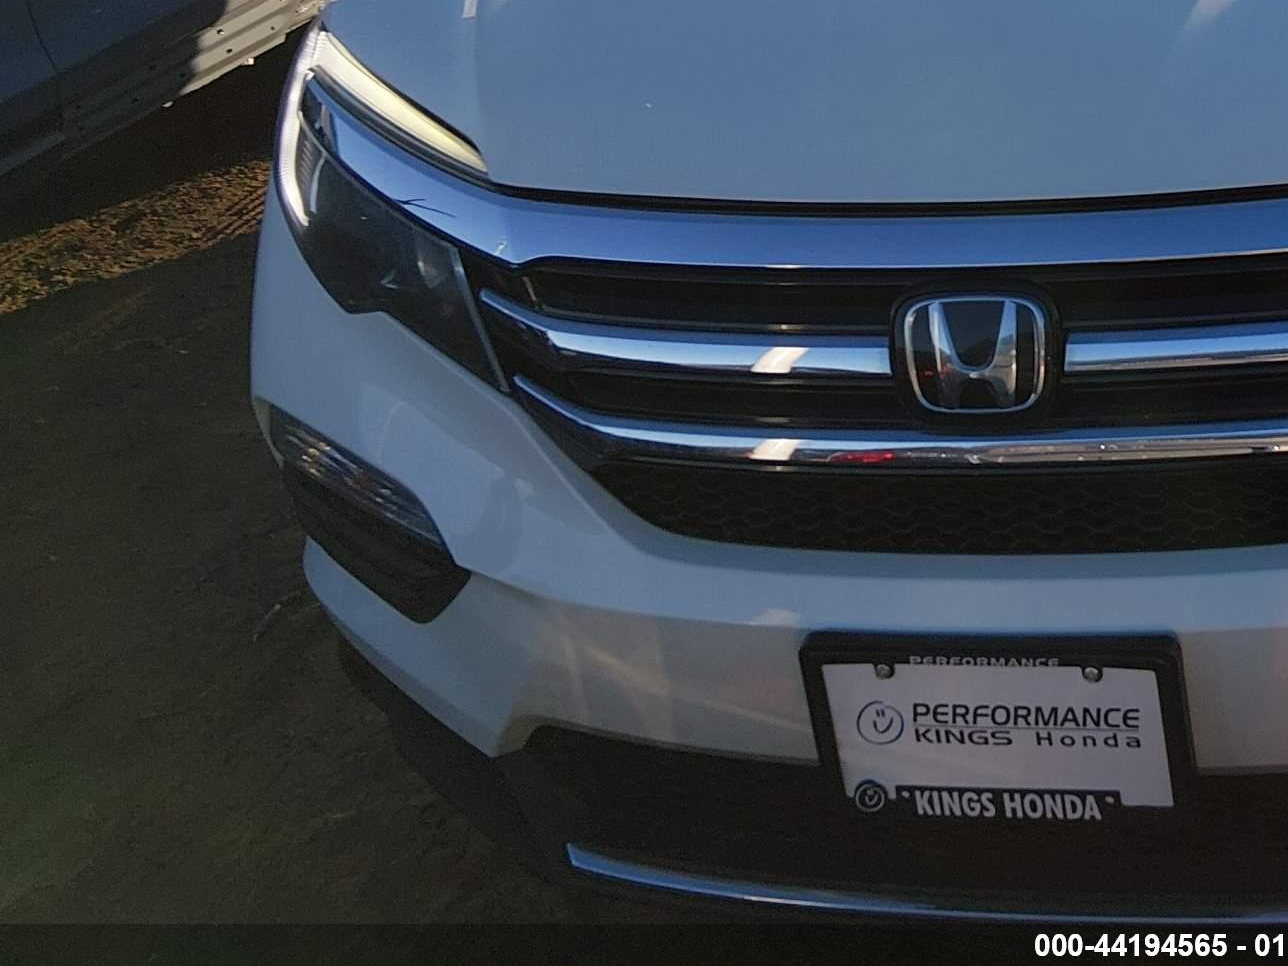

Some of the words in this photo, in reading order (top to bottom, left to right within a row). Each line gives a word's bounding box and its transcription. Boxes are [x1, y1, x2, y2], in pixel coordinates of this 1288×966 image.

[909, 655, 1060, 667] PERFORMANCE
[912, 702, 1140, 729] PERFORMANCE
[914, 728, 1013, 746] KINGS
[1036, 731, 1142, 748] Honda
[914, 789, 996, 818] KINGS
[1003, 791, 1102, 820] HONDA
